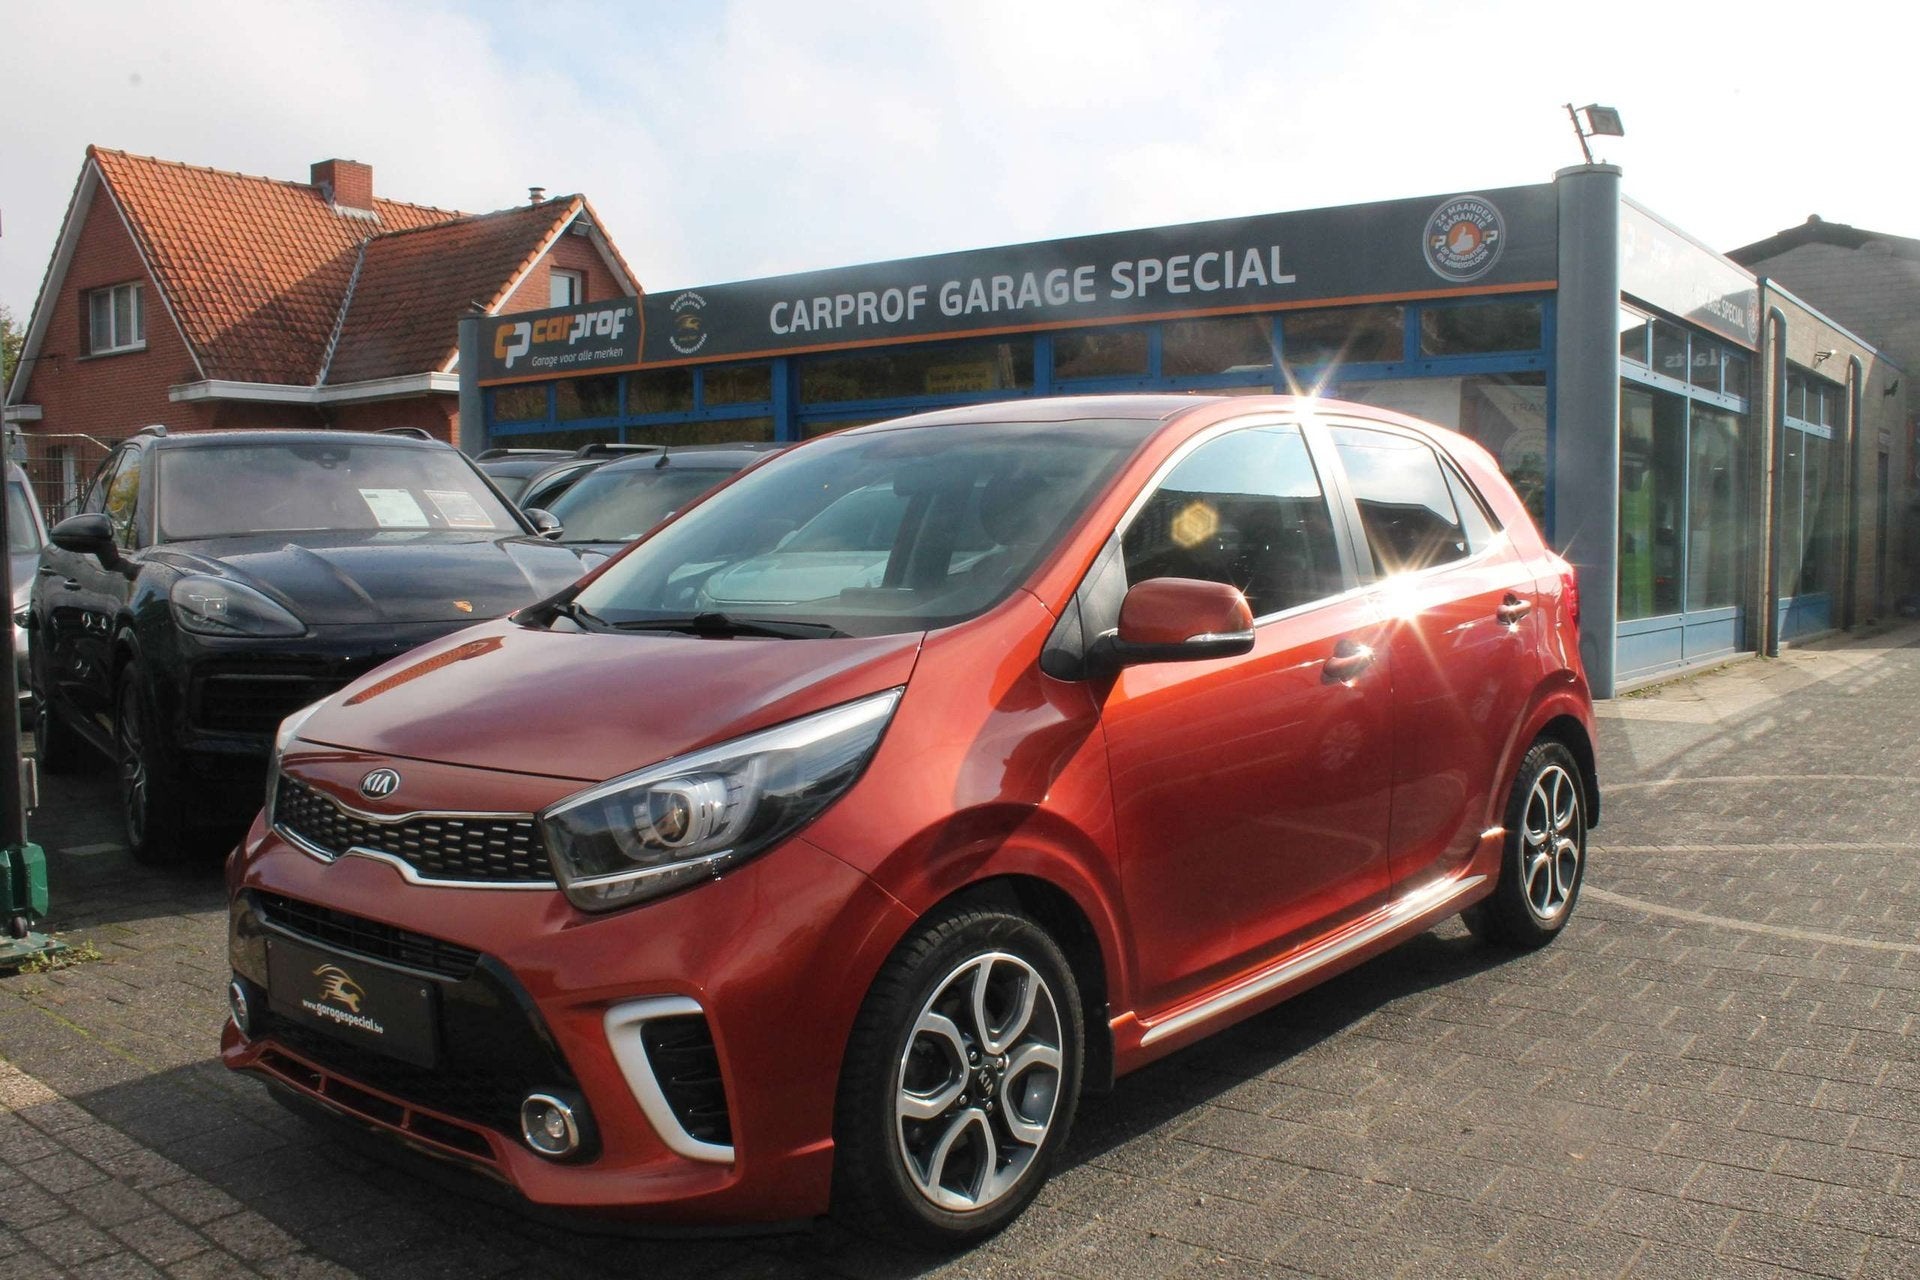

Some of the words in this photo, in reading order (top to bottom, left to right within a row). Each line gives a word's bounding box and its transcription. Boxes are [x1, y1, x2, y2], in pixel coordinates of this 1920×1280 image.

[1435, 213, 1447, 227] 24
[1447, 203, 1495, 223] MAANDEN
[1442, 212, 1487, 232] GARANTIE
[769, 285, 928, 335] CARPROF
[939, 265, 1097, 317] GARAGE
[1110, 245, 1296, 299] SPECIAL
[531, 355, 558, 368] Garage
[559, 353, 577, 364] voor
[578, 350, 592, 362] alle
[594, 347, 624, 360] merken
[362, 772, 392, 794] KIA
[302, 999, 384, 1034] www.garagespecial.be
[978, 1069, 994, 1096] KIA
